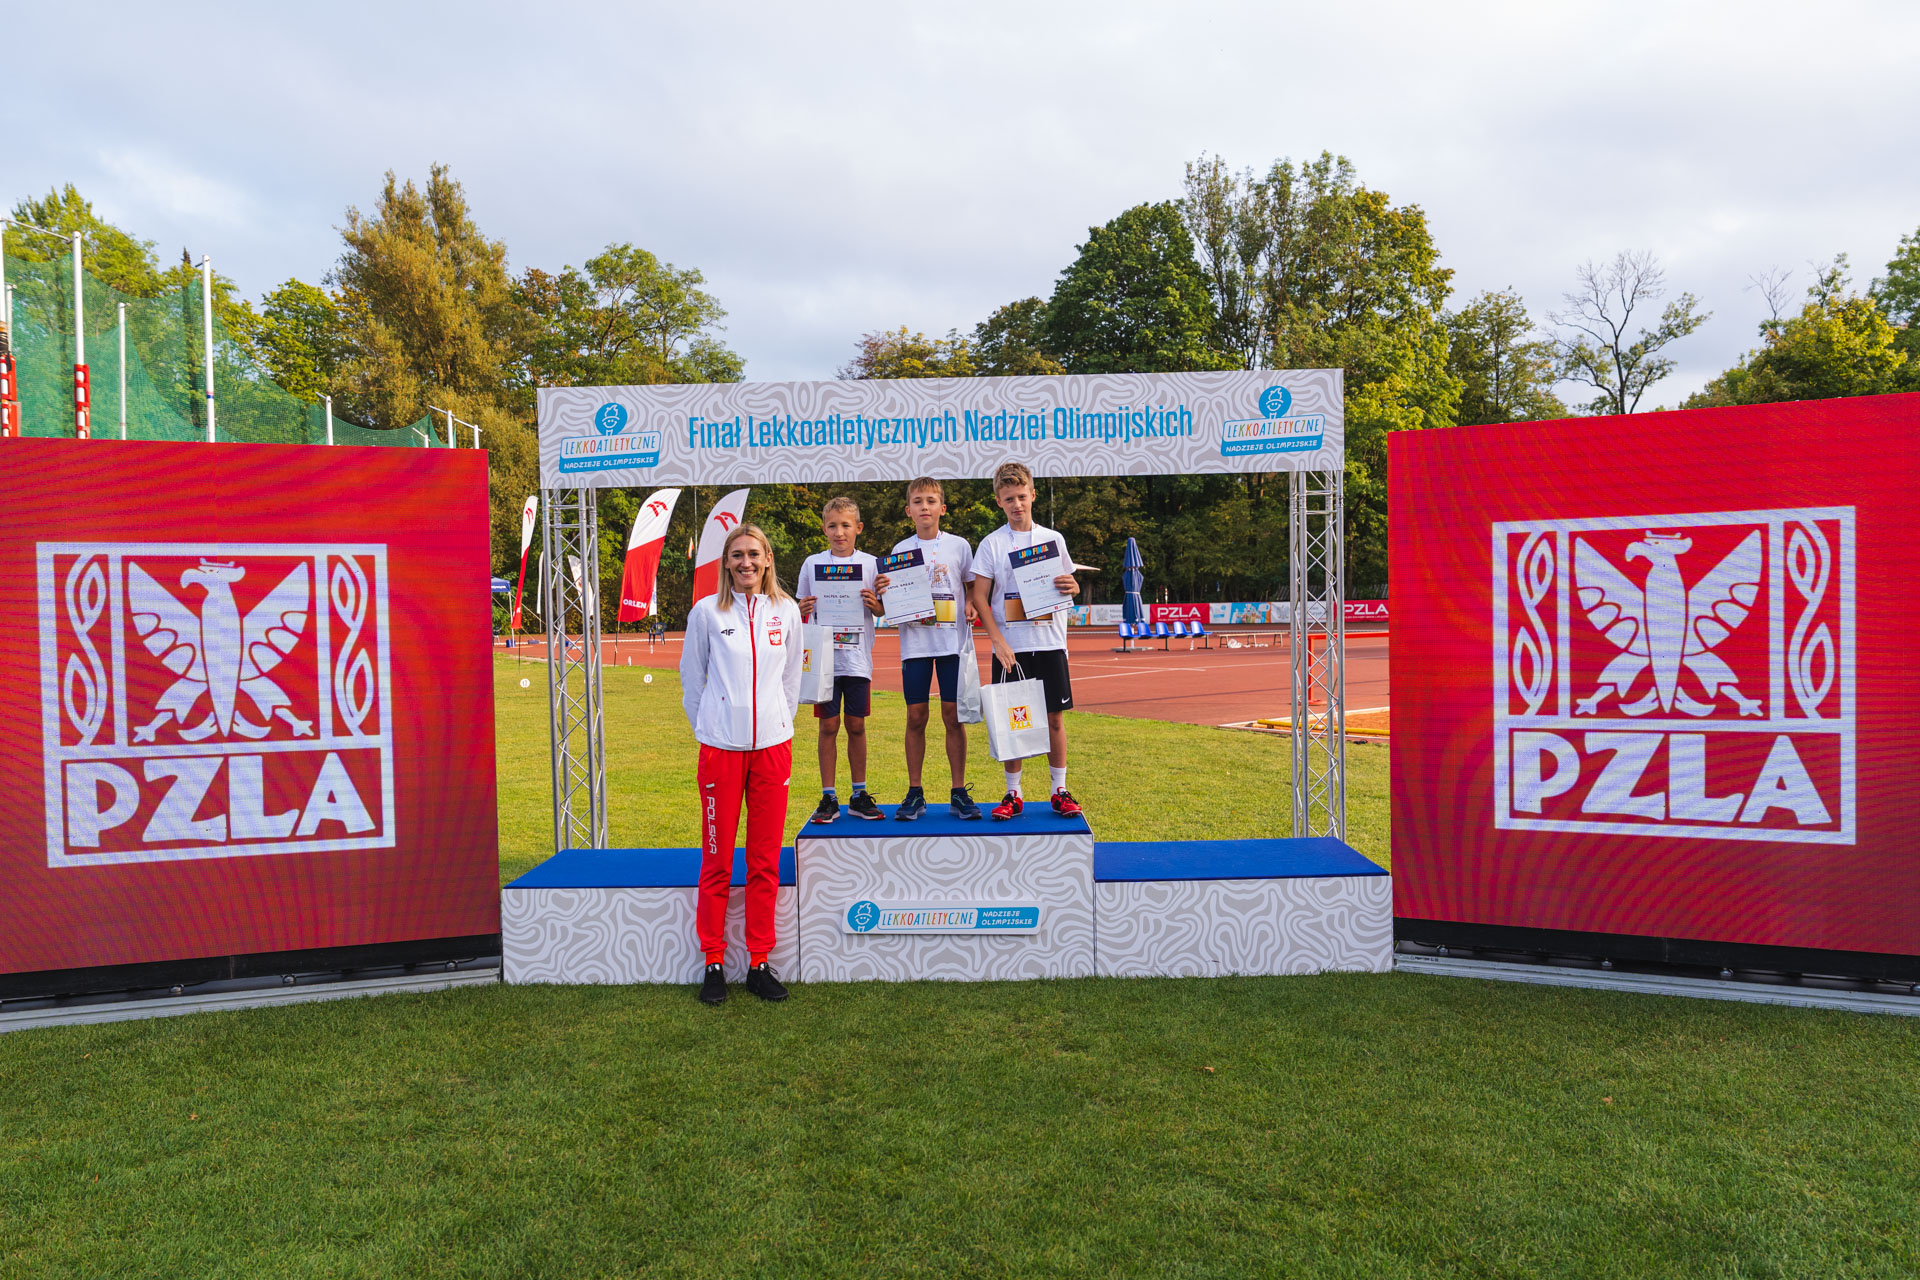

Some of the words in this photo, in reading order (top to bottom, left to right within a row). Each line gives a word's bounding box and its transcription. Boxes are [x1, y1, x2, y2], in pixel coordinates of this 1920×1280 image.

[689, 415, 742, 449] Finał
[749, 410, 957, 450] Lekkoatletycznych
[964, 408, 1046, 442] Nadziei
[1053, 404, 1192, 444] Olimpijskich
[1227, 418, 1320, 438] LEKKOATLETYCZNE
[564, 435, 656, 455] LEKKOATLETYCZNE
[1225, 443, 1264, 452] NADZIEJE
[1265, 440, 1318, 450] OLIMPIJSKIE
[563, 460, 601, 469] NADZIEJE
[602, 456, 654, 467] OLIMPIJSKIE
[623, 598, 647, 609] ORLEN
[1157, 606, 1201, 618] PZLA
[720, 628, 736, 636] 4F
[1513, 731, 1833, 825] PZLA
[66, 752, 376, 848] PZLA
[706, 795, 717, 855] POLSKA
[882, 911, 974, 926] LEKKOATLETYCZNE
[981, 918, 1033, 926] OLIMPIJSKIE
